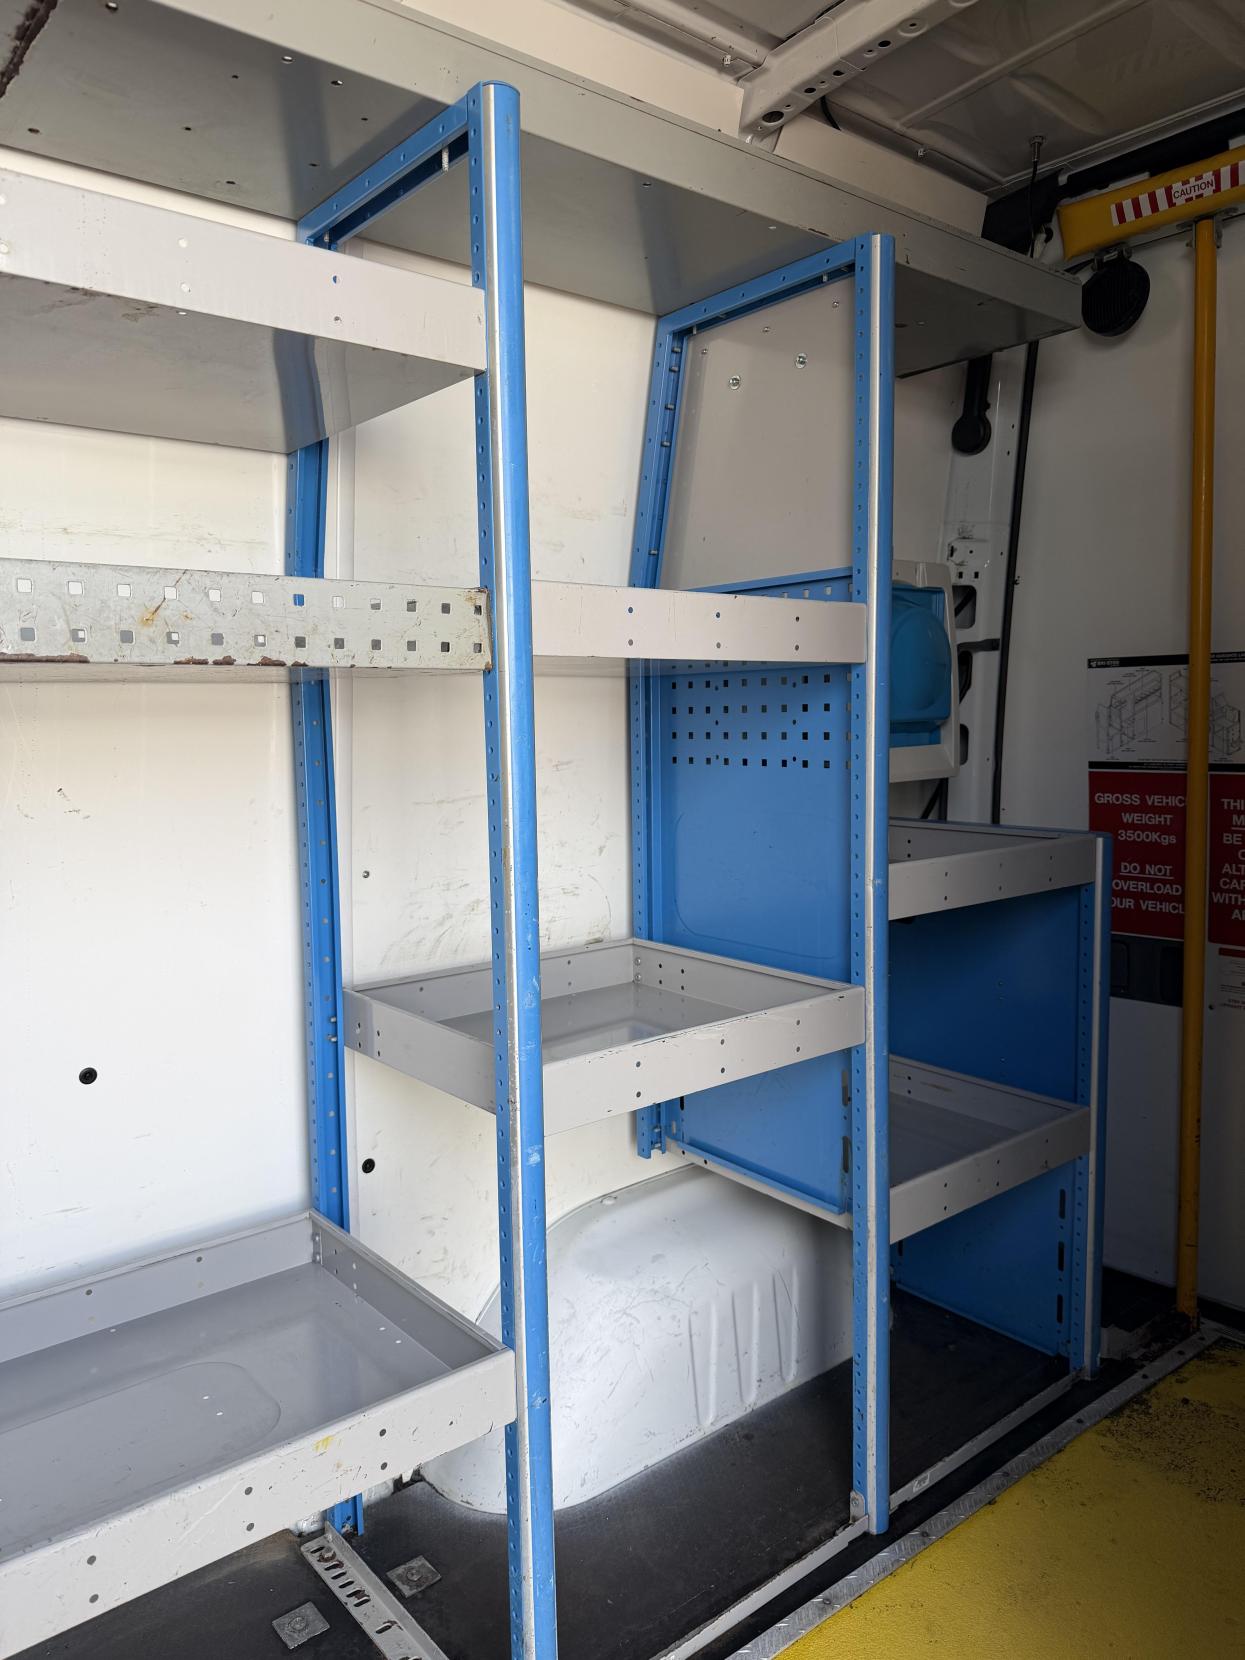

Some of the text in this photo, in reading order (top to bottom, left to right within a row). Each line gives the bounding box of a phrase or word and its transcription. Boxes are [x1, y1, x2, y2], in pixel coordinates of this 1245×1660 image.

[1173, 179, 1214, 199] CAUTION
[1094, 793, 1185, 807] GROSS VEHIC
[1220, 798, 1245, 810] THI
[1121, 812, 1174, 826] WEIGHT
[1117, 829, 1177, 845] 3500Kgs
[1223, 830, 1243, 844] BE
[1120, 862, 1173, 876] DO NOT
[1221, 863, 1245, 875] ALT
[1112, 879, 1182, 896] OVERLOAD
[1111, 896, 1186, 914] OUR VEHICL
[1211, 891, 1245, 905] WITH
